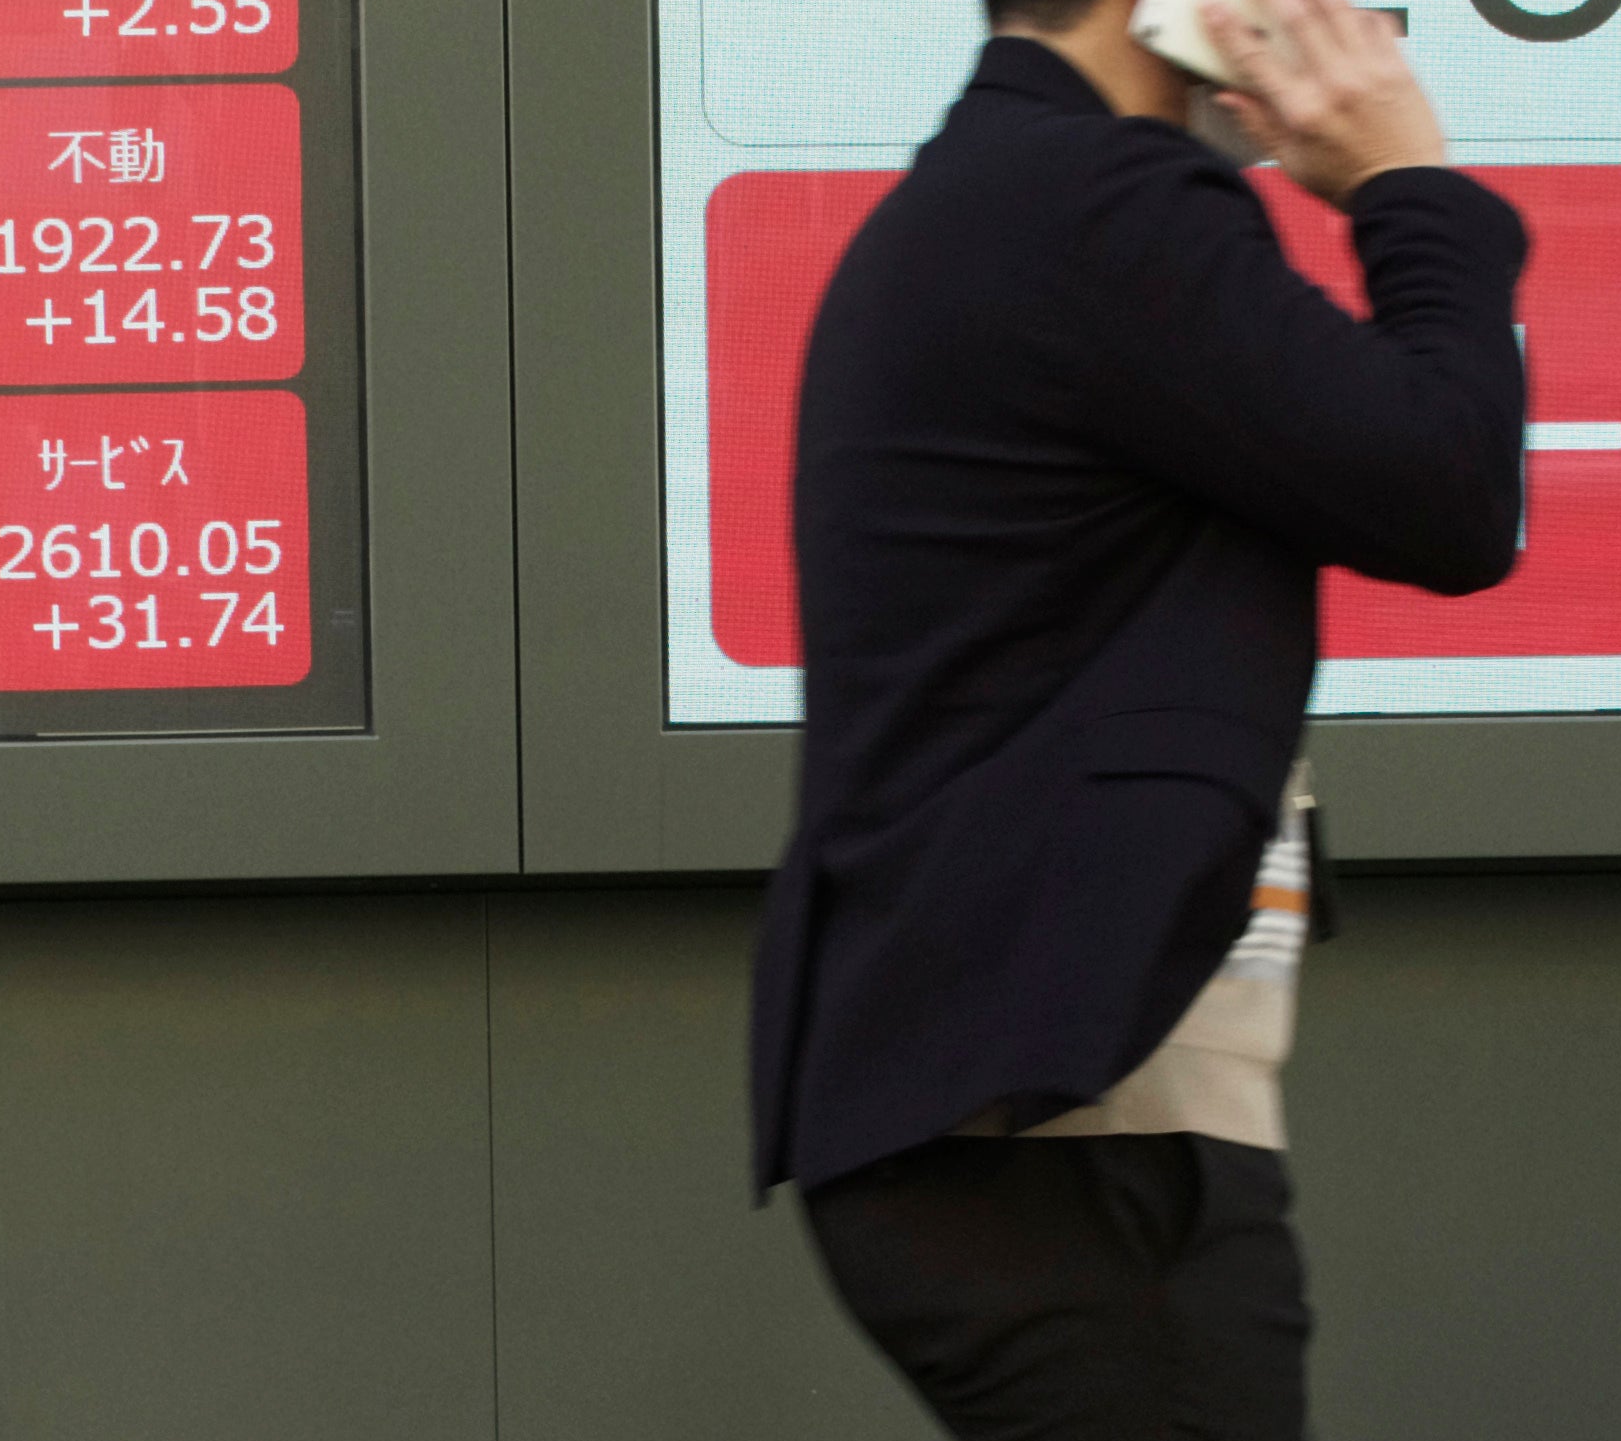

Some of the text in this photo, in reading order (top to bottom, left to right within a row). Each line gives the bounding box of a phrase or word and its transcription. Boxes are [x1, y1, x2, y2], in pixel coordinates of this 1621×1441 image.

[47, 127, 166, 184] 不動
[26, 286, 278, 345] +14.58
[38, 435, 190, 491] サービス
[32, 591, 285, 651] +31.74
